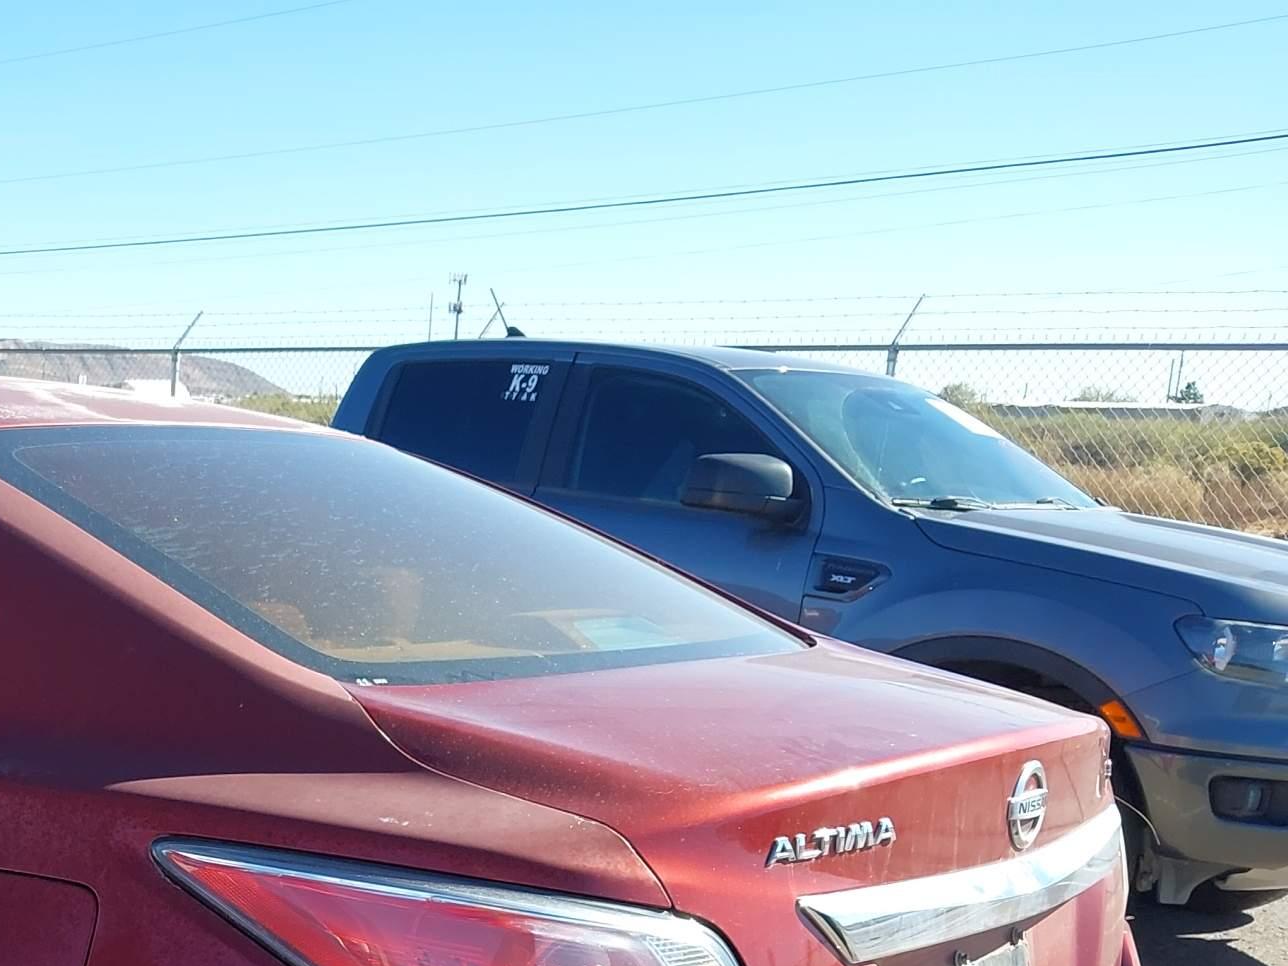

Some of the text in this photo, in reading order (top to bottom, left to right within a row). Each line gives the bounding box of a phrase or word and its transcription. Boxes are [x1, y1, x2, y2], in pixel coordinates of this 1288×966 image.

[511, 364, 550, 375] WORKING
[509, 374, 539, 393] K-9
[830, 574, 857, 584] XLT
[764, 817, 897, 868] ALTIMA
